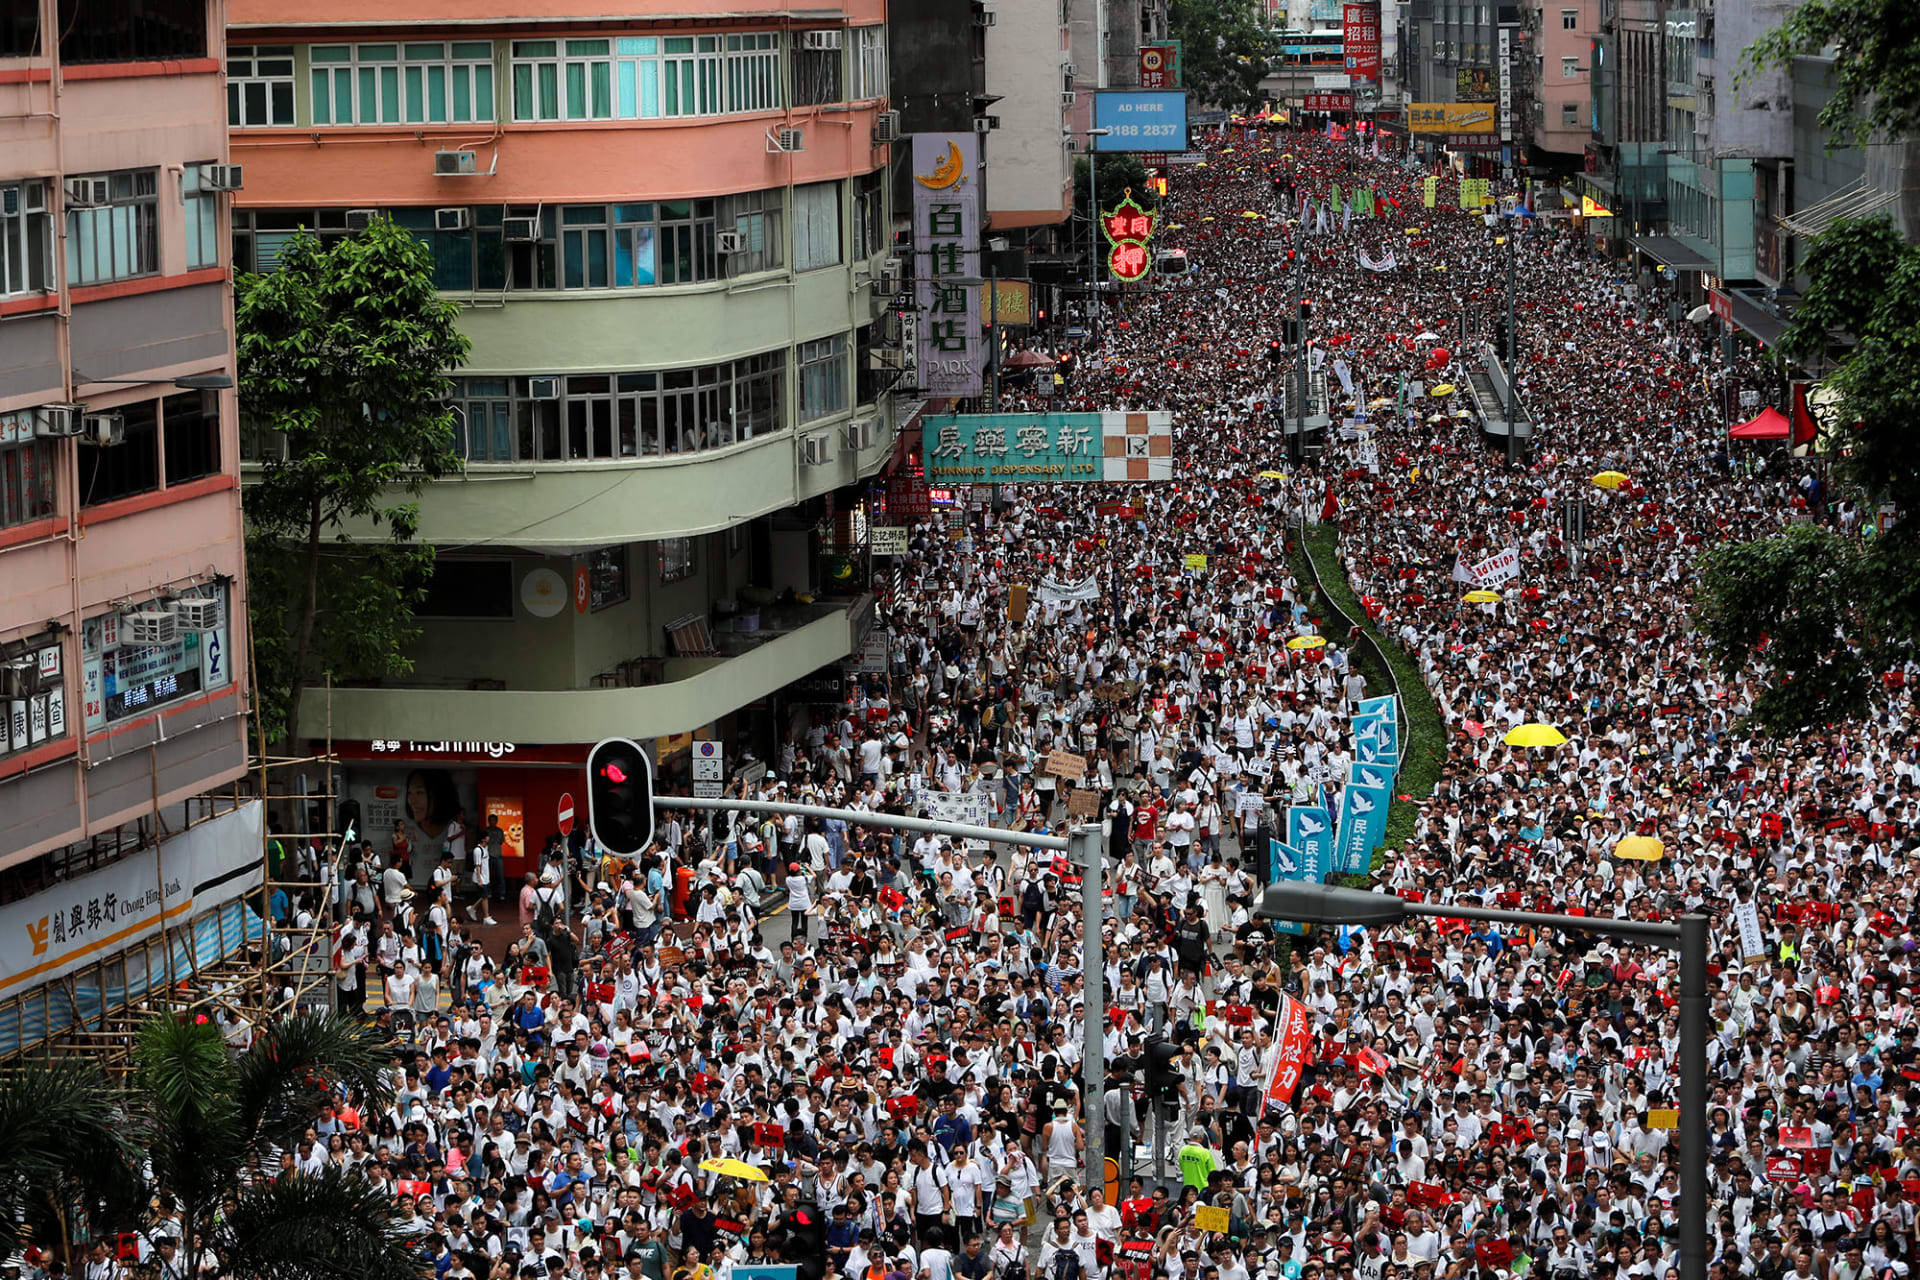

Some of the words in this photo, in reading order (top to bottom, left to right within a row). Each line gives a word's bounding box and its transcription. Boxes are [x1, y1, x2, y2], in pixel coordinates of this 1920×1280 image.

[1346, 8, 1375, 24] 廣告
[1346, 26, 1376, 41] 招租
[1118, 104, 1133, 112] AD
[1136, 104, 1164, 112] HERE
[1105, 125, 1138, 136] 3188
[1143, 125, 1177, 136] 2837
[1113, 244, 1143, 275] 押
[930, 203, 967, 352] 百佳酒店
[927, 359, 972, 376] PARK
[930, 465, 986, 477] SUNNING
[991, 463, 1066, 476] DISPENSARY
[1071, 463, 1097, 475] LTD.
[41, 652, 52, 669] 1/F
[712, 771, 719, 779] 8
[1349, 818, 1368, 869] 民主黨
[120, 897, 145, 917] Chong
[165, 878, 182, 898] Bank
[52, 892, 118, 944] 創興銀行
[316, 959, 323, 968] 7
[1361, 1265, 1378, 1279] GAP
